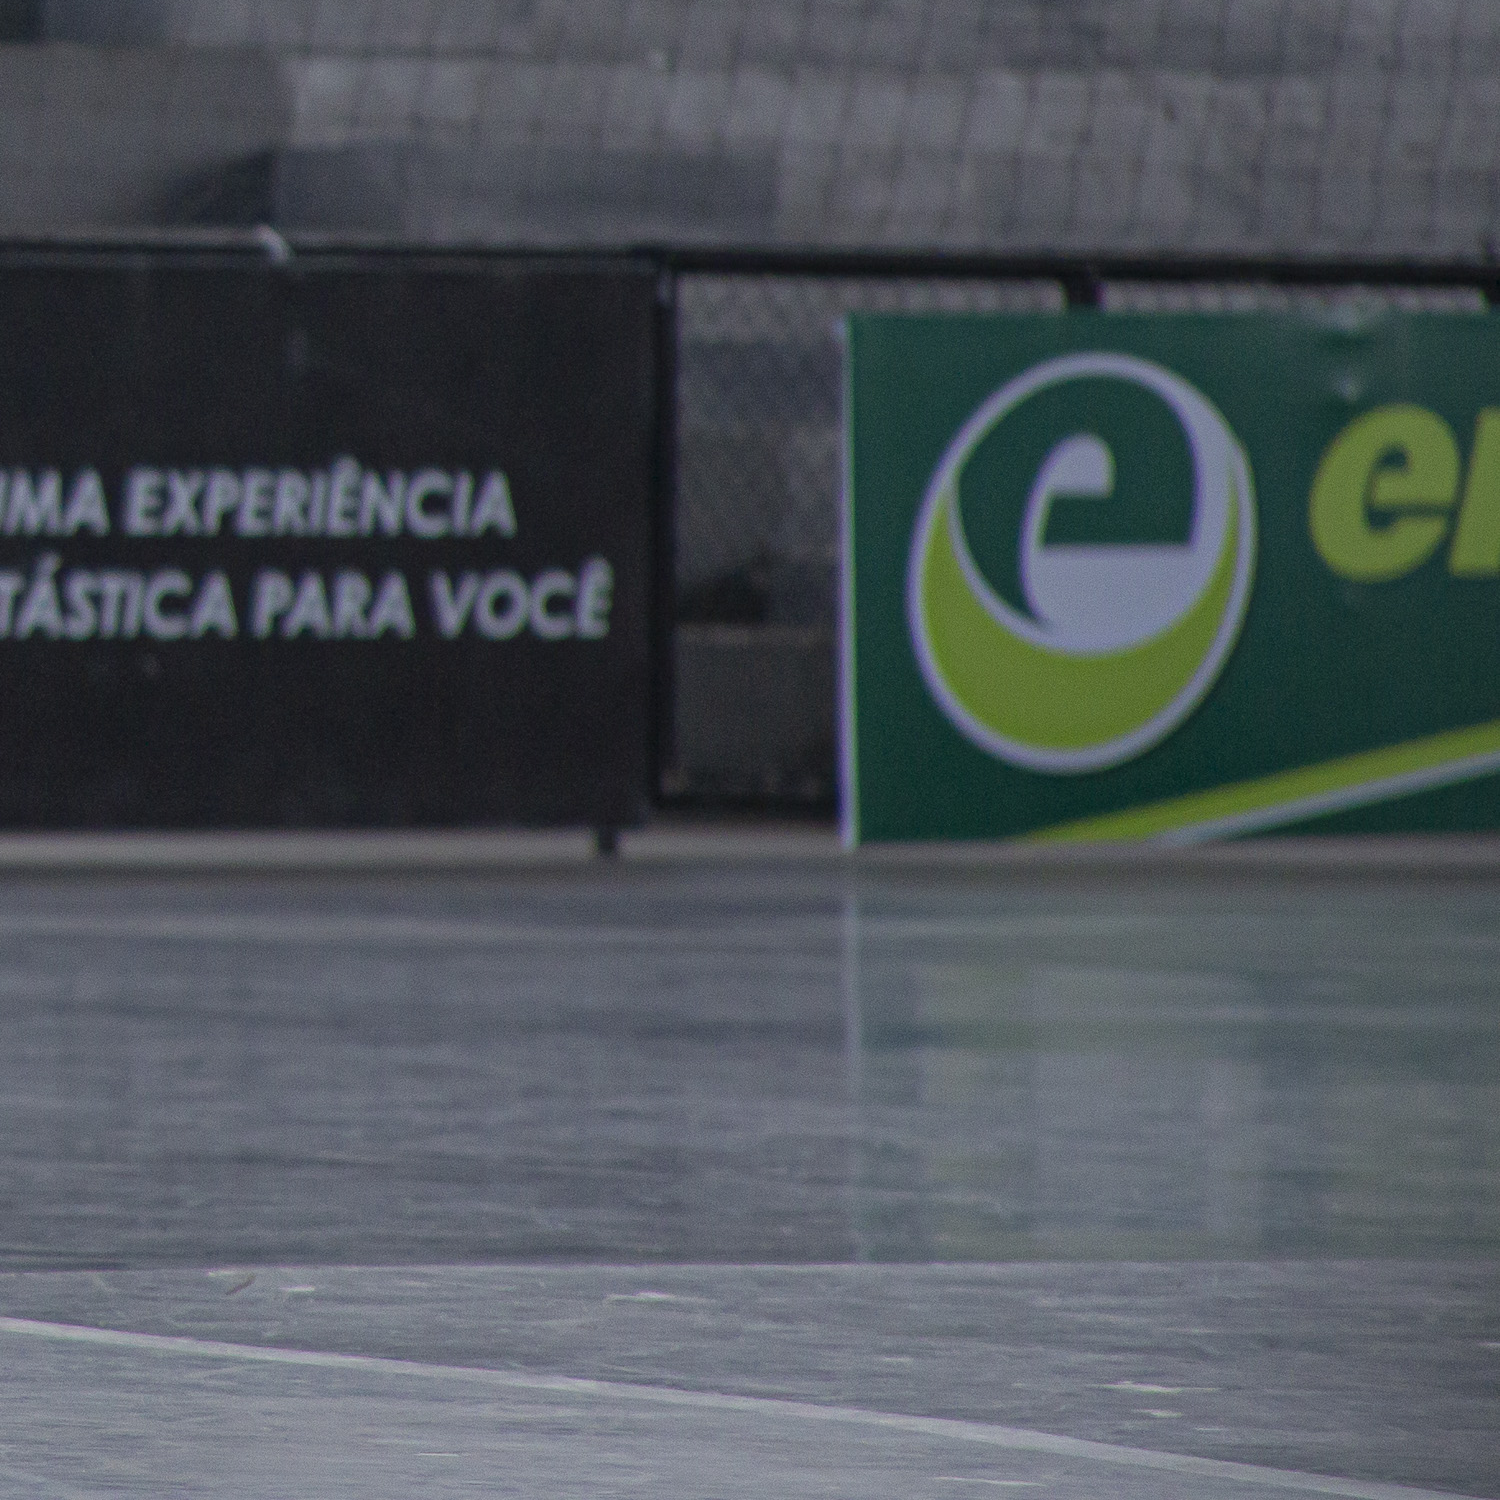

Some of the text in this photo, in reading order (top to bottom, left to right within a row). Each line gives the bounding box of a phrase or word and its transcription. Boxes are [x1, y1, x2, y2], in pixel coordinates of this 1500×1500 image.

[122, 454, 518, 538] EXPERIÊNCIA
[248, 568, 415, 640] PARA
[428, 556, 614, 640] VOCÊ
